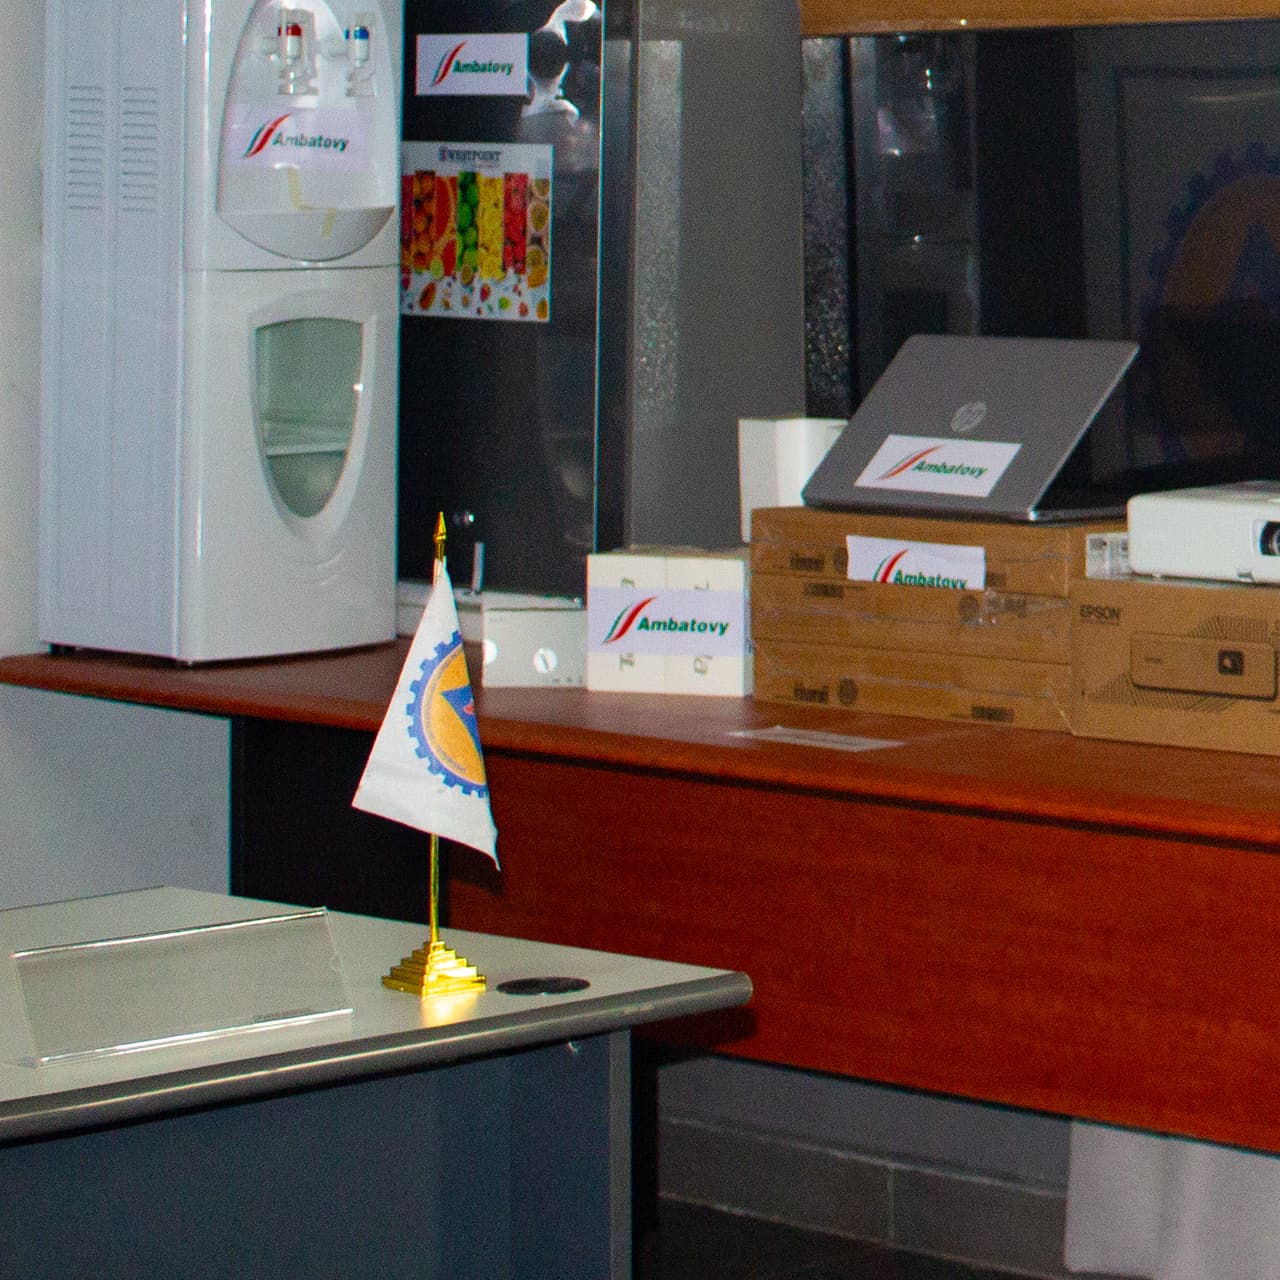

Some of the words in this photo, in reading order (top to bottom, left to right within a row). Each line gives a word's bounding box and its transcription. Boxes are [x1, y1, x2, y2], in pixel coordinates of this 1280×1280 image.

[453, 59, 514, 75] Ambatovy
[271, 131, 350, 153] Ambatovy
[911, 460, 988, 479] Ambatovy
[1080, 604, 1120, 620] EPSON
[637, 617, 729, 636] Ambatovy
